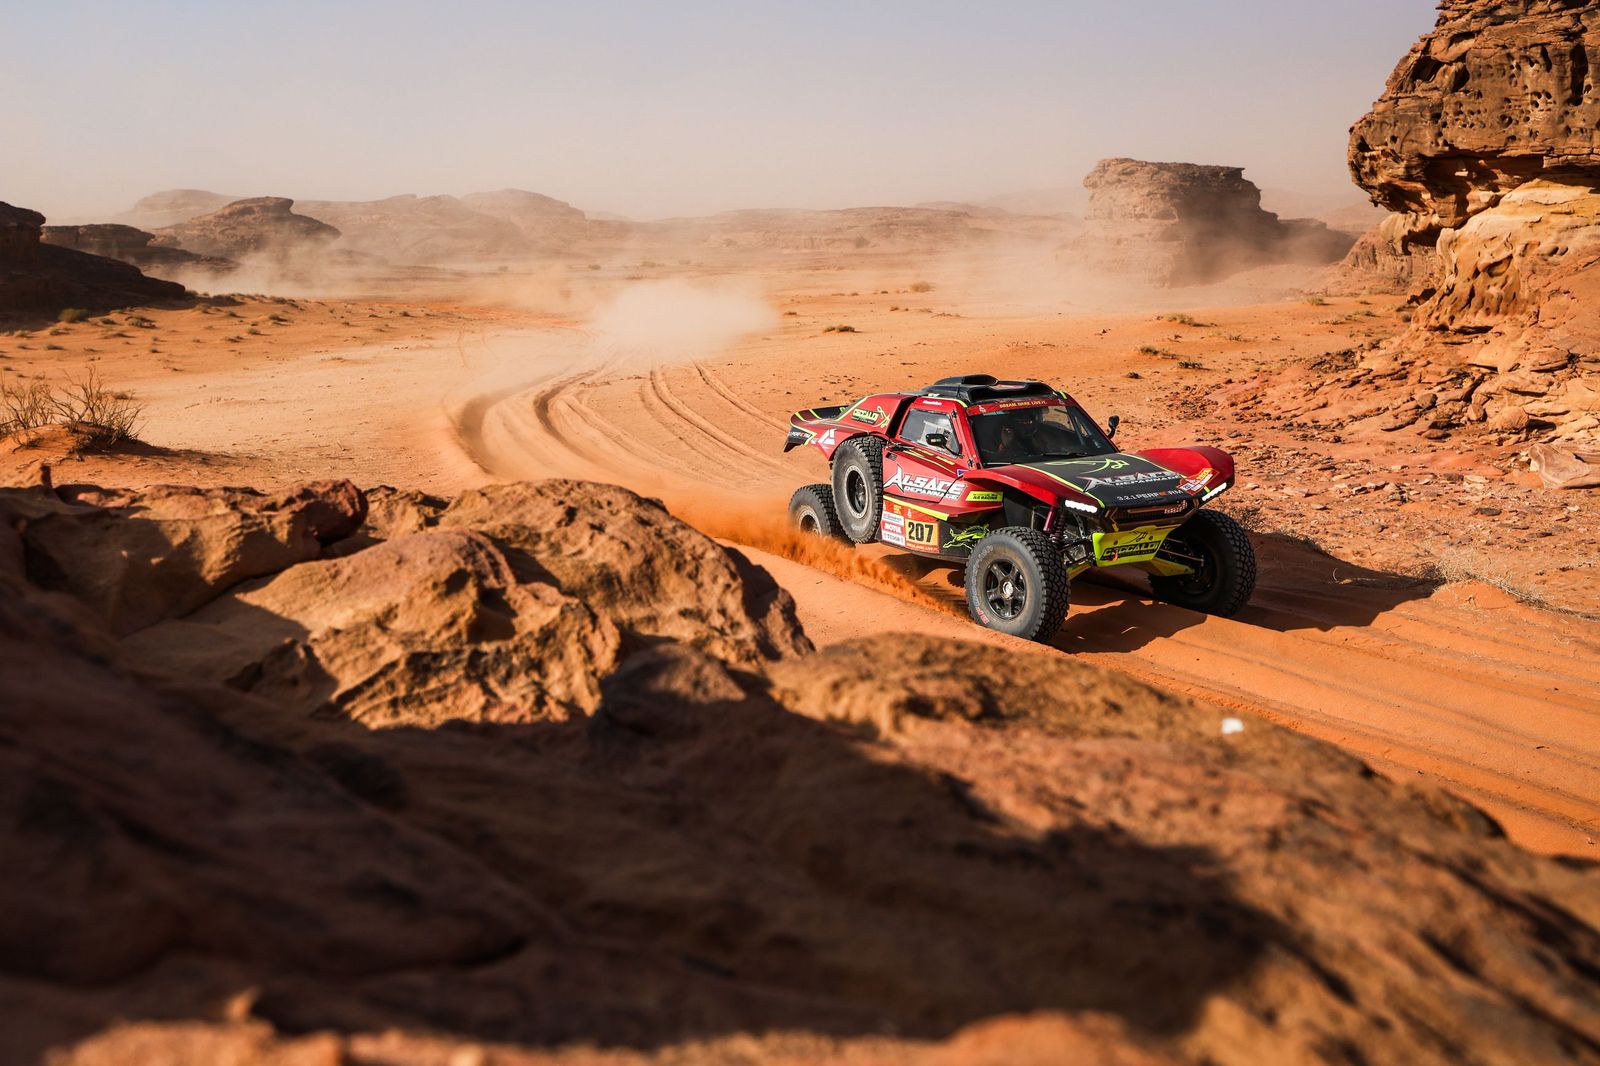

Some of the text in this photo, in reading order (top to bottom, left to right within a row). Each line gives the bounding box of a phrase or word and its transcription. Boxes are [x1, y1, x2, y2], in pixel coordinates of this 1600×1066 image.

[883, 463, 966, 495] ALSACE
[903, 485, 961, 500] DEPANNAGE
[908, 521, 934, 543] 207
